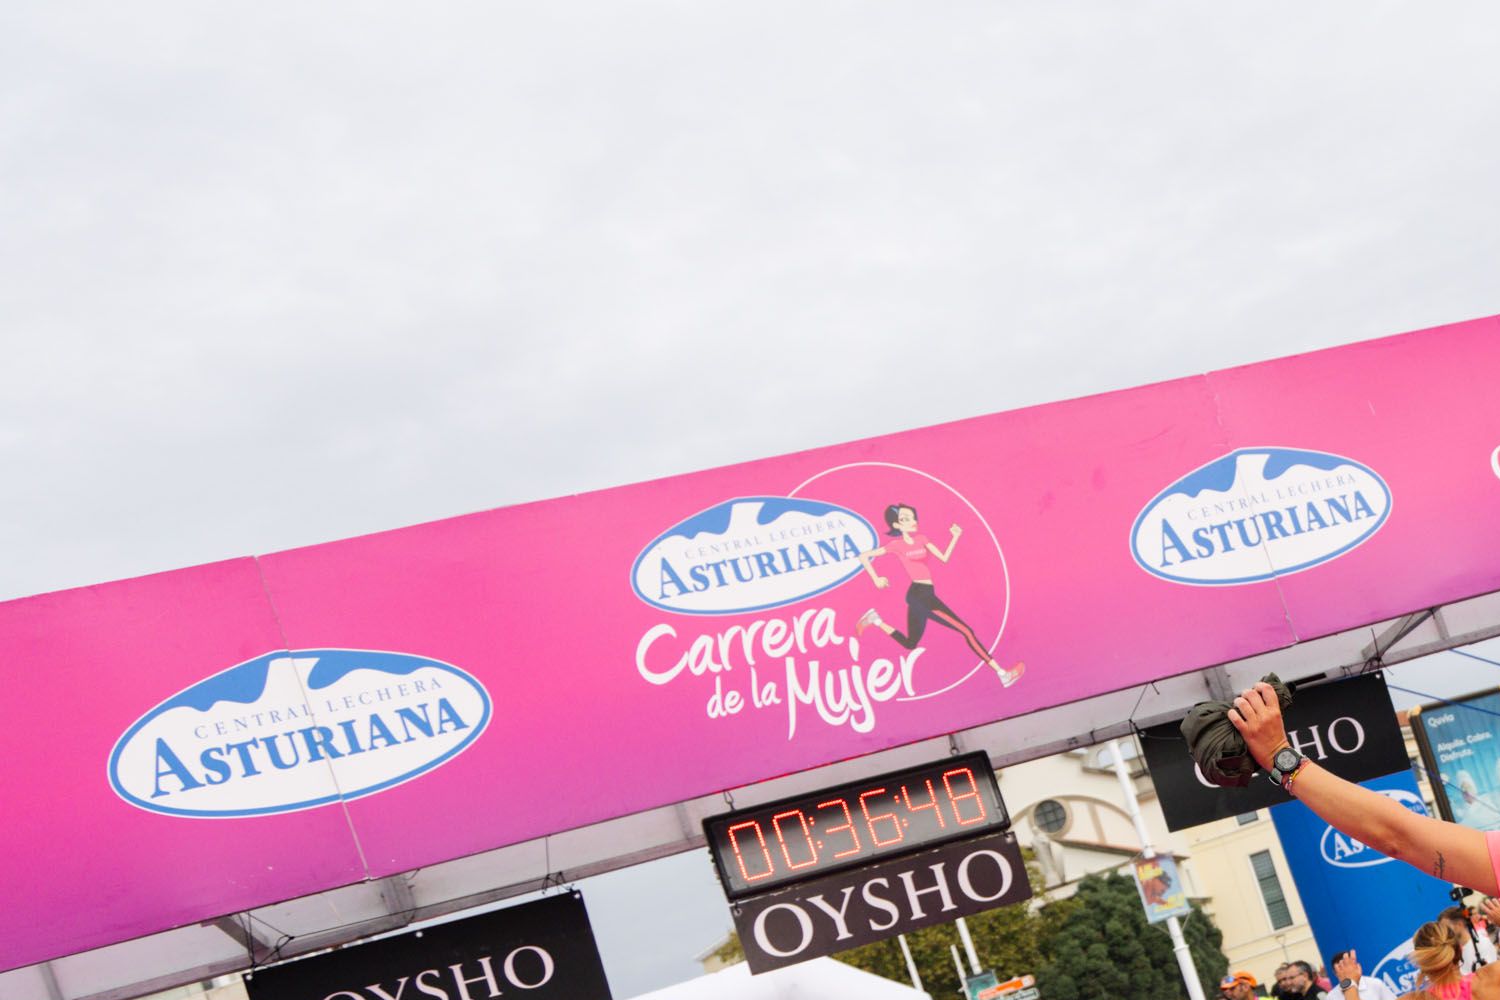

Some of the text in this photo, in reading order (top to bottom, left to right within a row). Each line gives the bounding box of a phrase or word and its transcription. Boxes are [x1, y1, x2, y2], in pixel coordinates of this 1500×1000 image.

[1160, 490, 1376, 568] ASTURIANA
[1187, 473, 1357, 521] CENTRAL LECHERA
[659, 533, 861, 600] ASTURIANA
[684, 519, 847, 559] CENTRAL LECHERA
[636, 607, 843, 685] Carrera
[194, 677, 443, 740] CENTRAL LECHERA
[706, 637, 926, 741] de la Mujer
[150, 696, 470, 799] ASTURIANA
[727, 767, 987, 883] 00:36:48
[751, 847, 1013, 958] OYSHO
